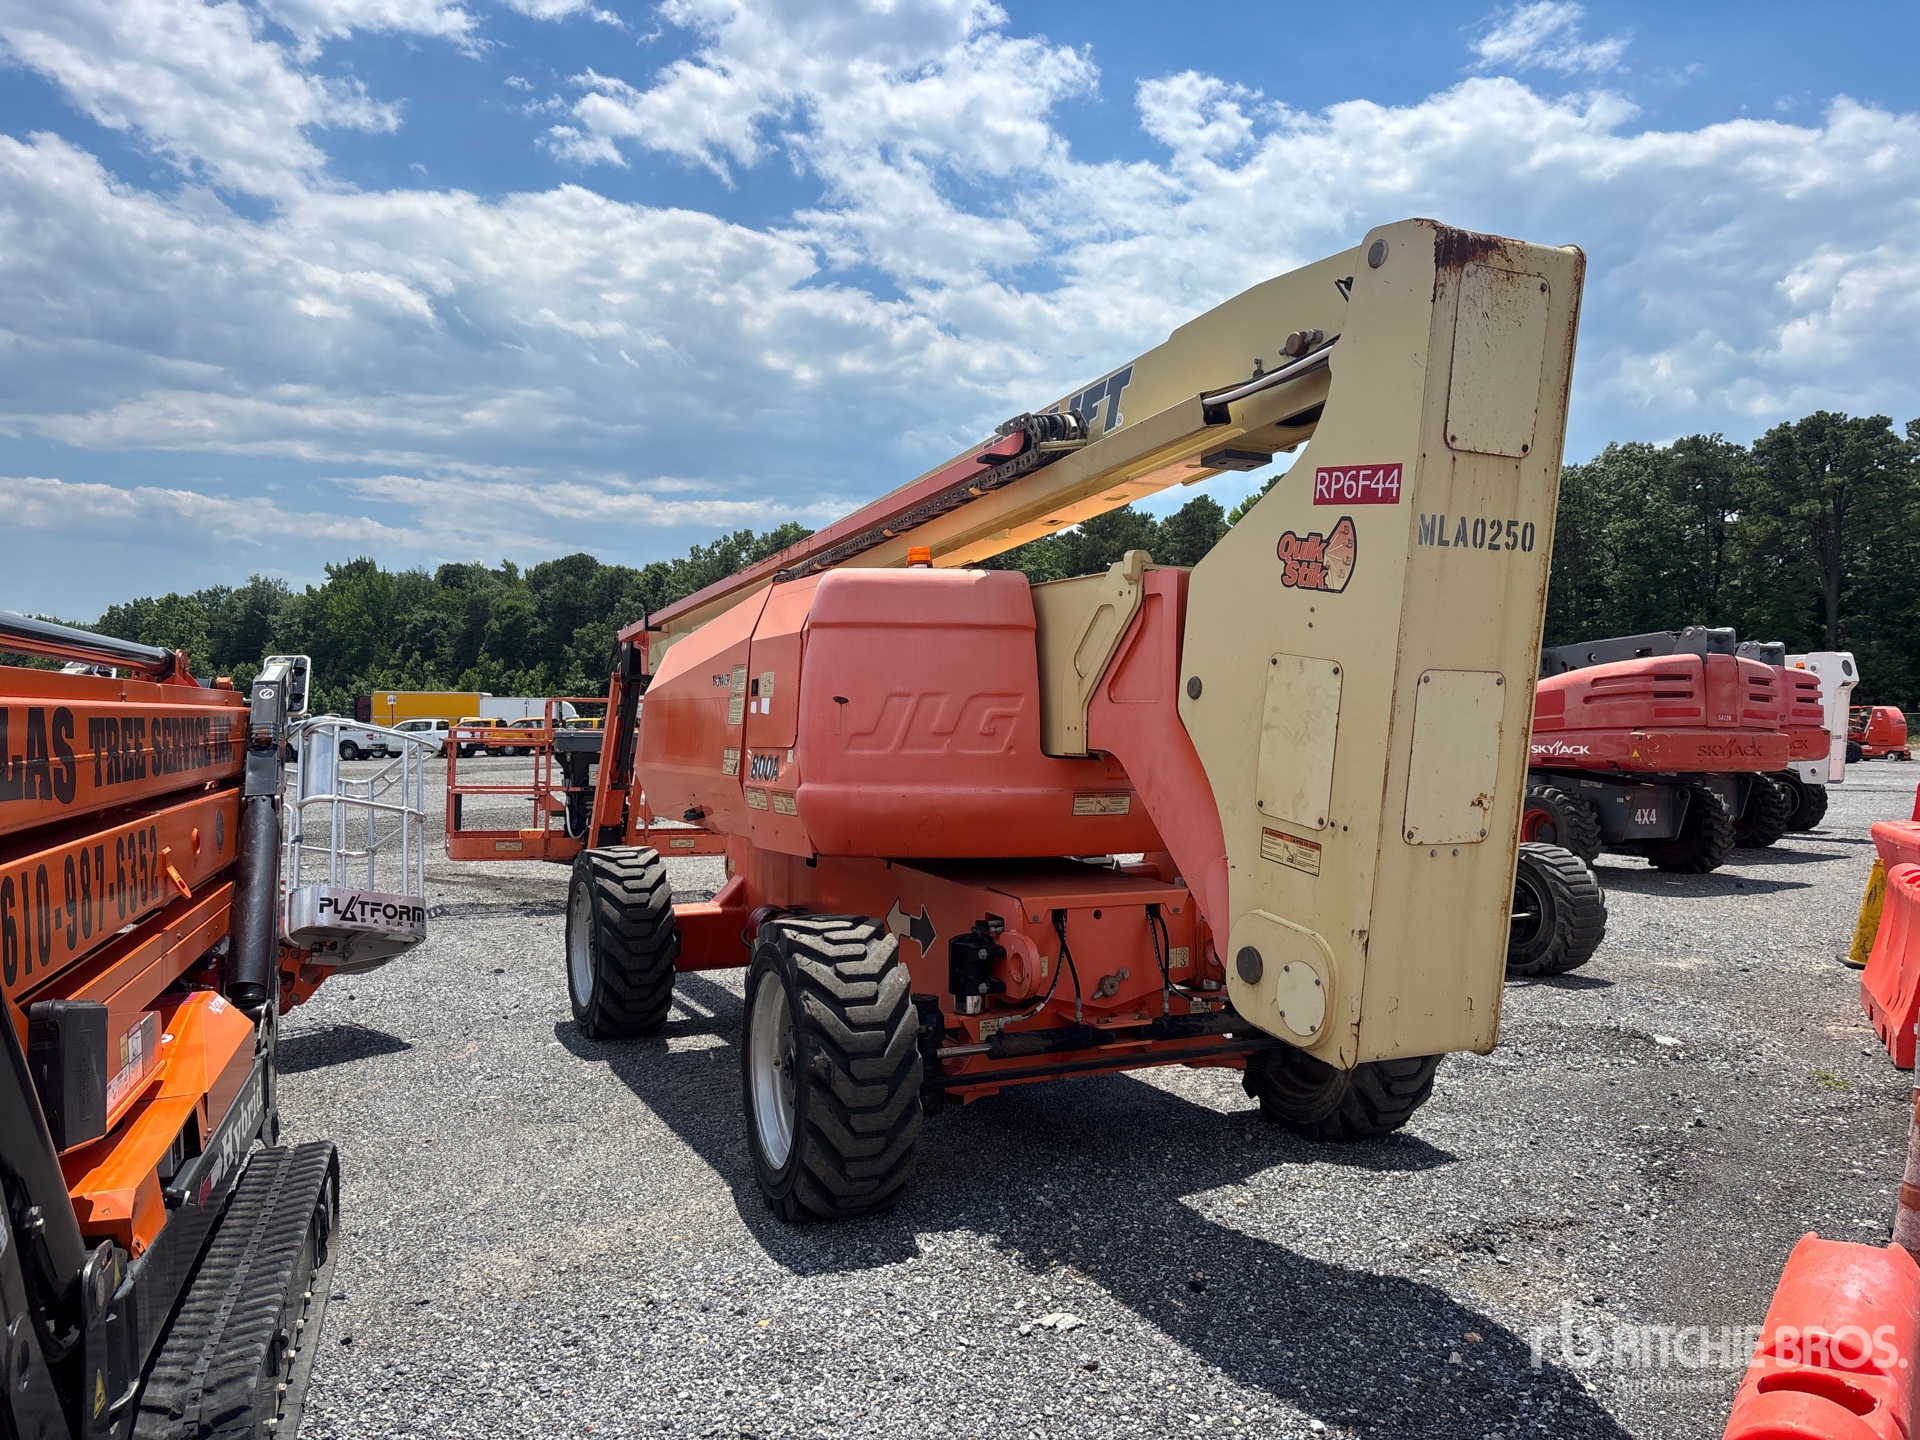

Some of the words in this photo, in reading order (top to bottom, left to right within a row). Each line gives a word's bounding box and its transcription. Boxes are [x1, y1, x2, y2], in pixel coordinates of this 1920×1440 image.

[1316, 468, 1400, 499] RP6F44
[1418, 513, 1535, 552] MLA0250
[1278, 534, 1327, 562] Quik
[1282, 560, 1328, 588] Stik
[846, 692, 1025, 754] JLG
[88, 716, 147, 788] TREE
[151, 716, 212, 777] SERVICE
[1530, 740, 1590, 756] SKYJACK
[1697, 737, 1763, 758] SKYJACK
[751, 752, 781, 783] 800A
[1634, 808, 1657, 825] 4X4
[1, 824, 159, 988] 610-987-6352
[319, 893, 425, 923] PLATFORM
[360, 917, 425, 929] BASKET
[221, 1073, 264, 1168] Hybrid
